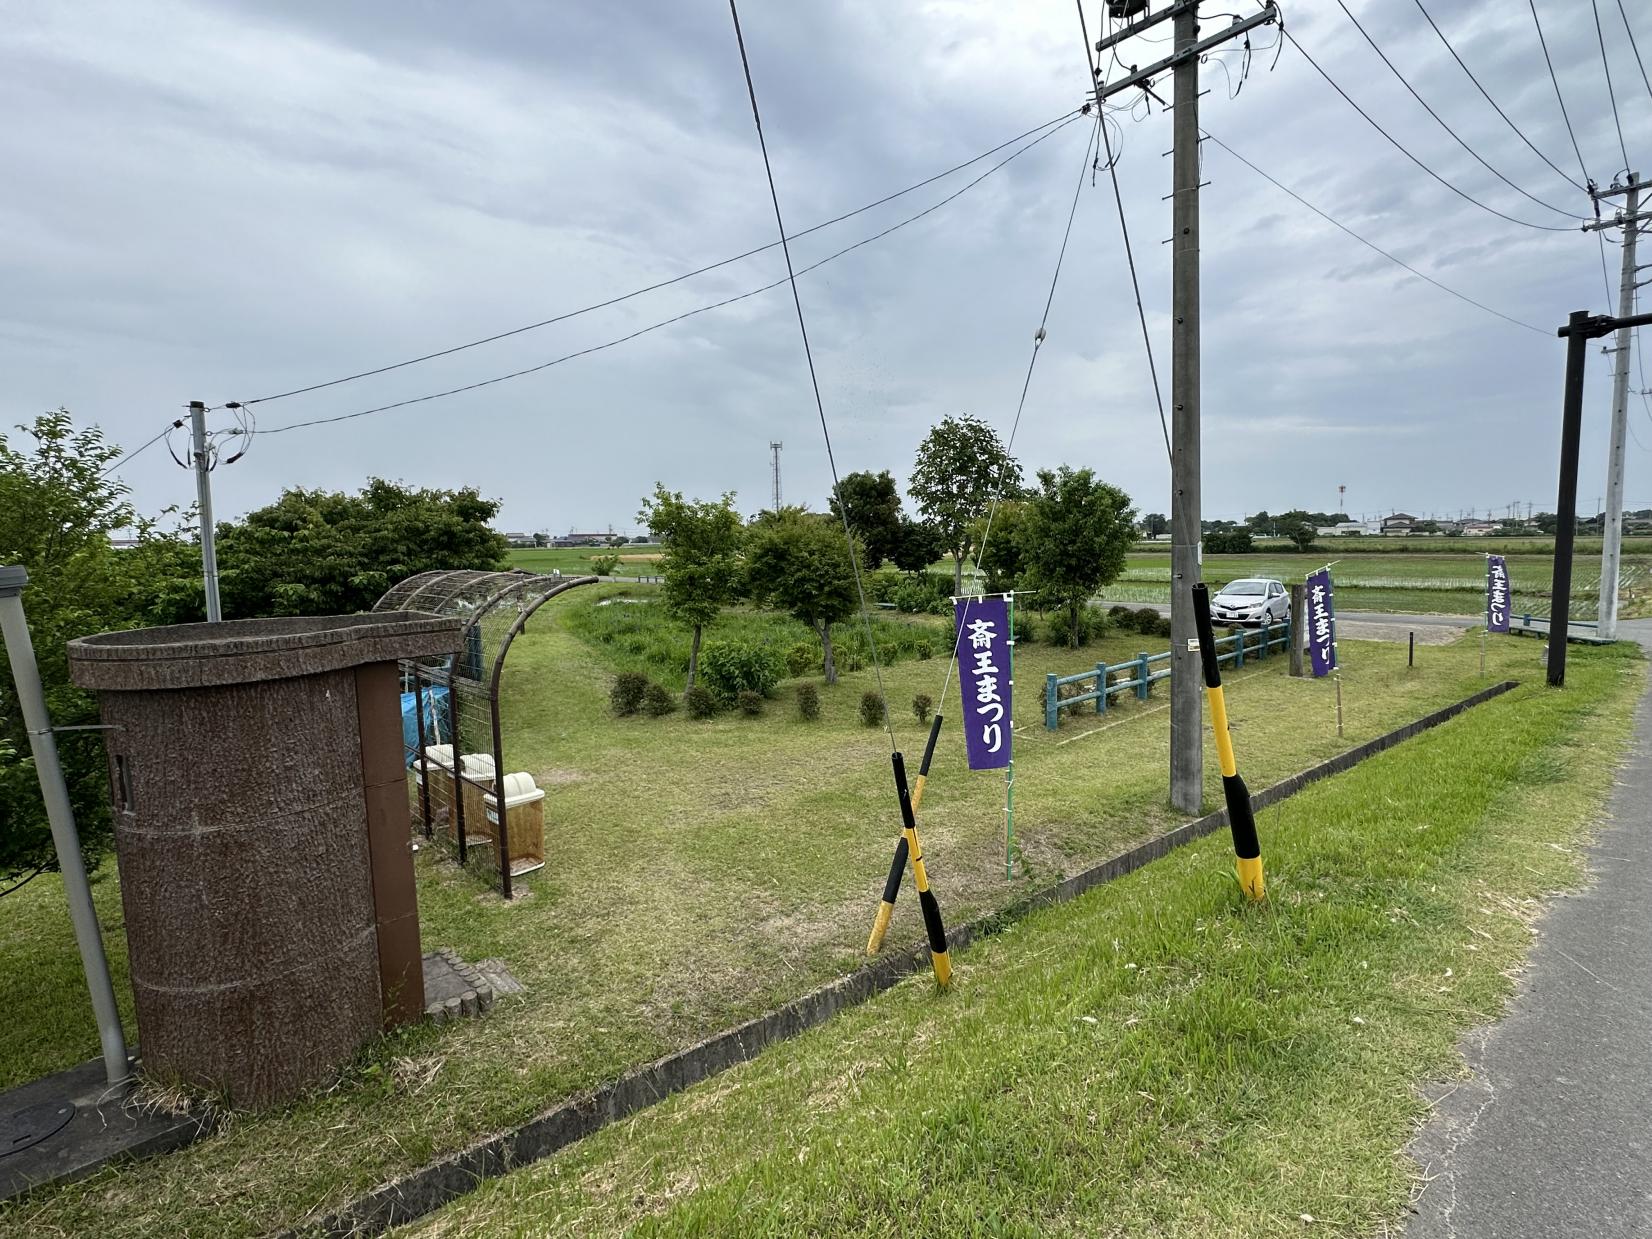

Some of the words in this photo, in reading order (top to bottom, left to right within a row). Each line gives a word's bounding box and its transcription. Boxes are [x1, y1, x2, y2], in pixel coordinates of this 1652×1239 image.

[966, 619, 1004, 753] 斎王まつり
